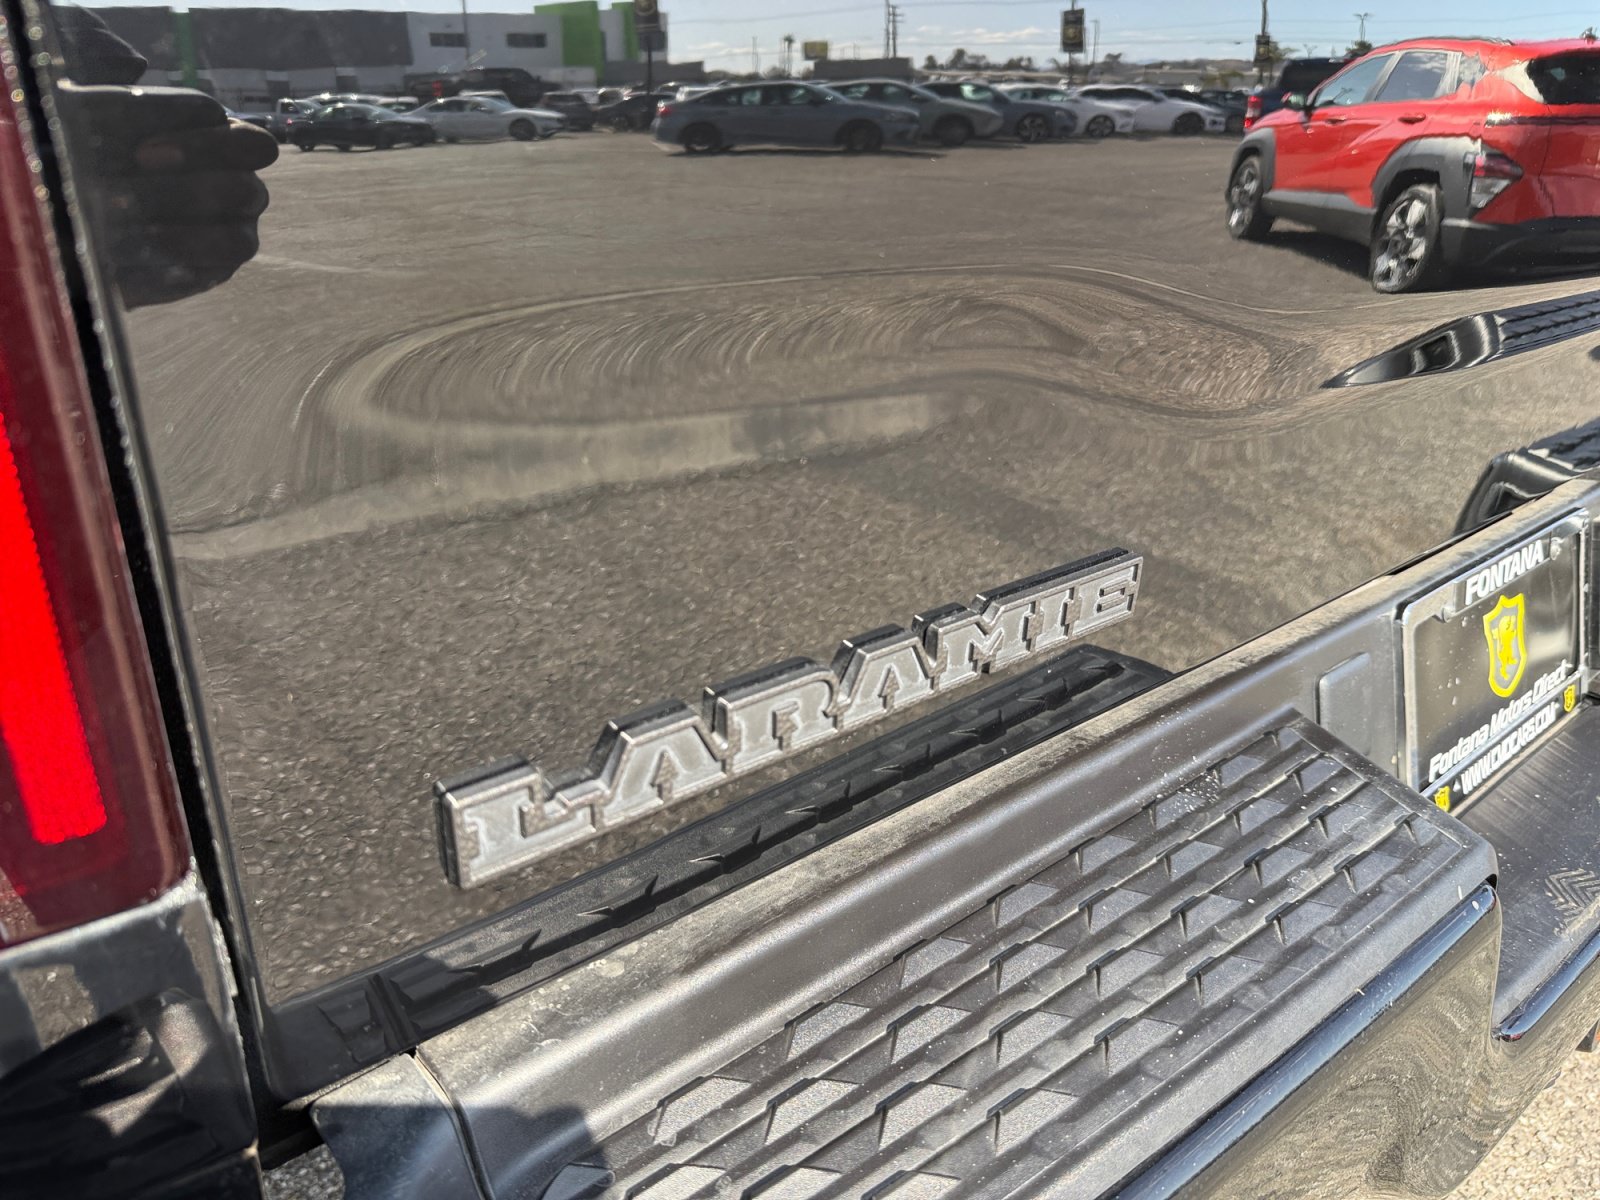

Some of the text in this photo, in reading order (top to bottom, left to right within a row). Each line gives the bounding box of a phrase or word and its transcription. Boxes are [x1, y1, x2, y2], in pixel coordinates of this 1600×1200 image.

[1465, 540, 1544, 605] FONTANA
[436, 548, 1143, 888] LARAMIE
[1428, 660, 1570, 783] Fontana Motors Direct
